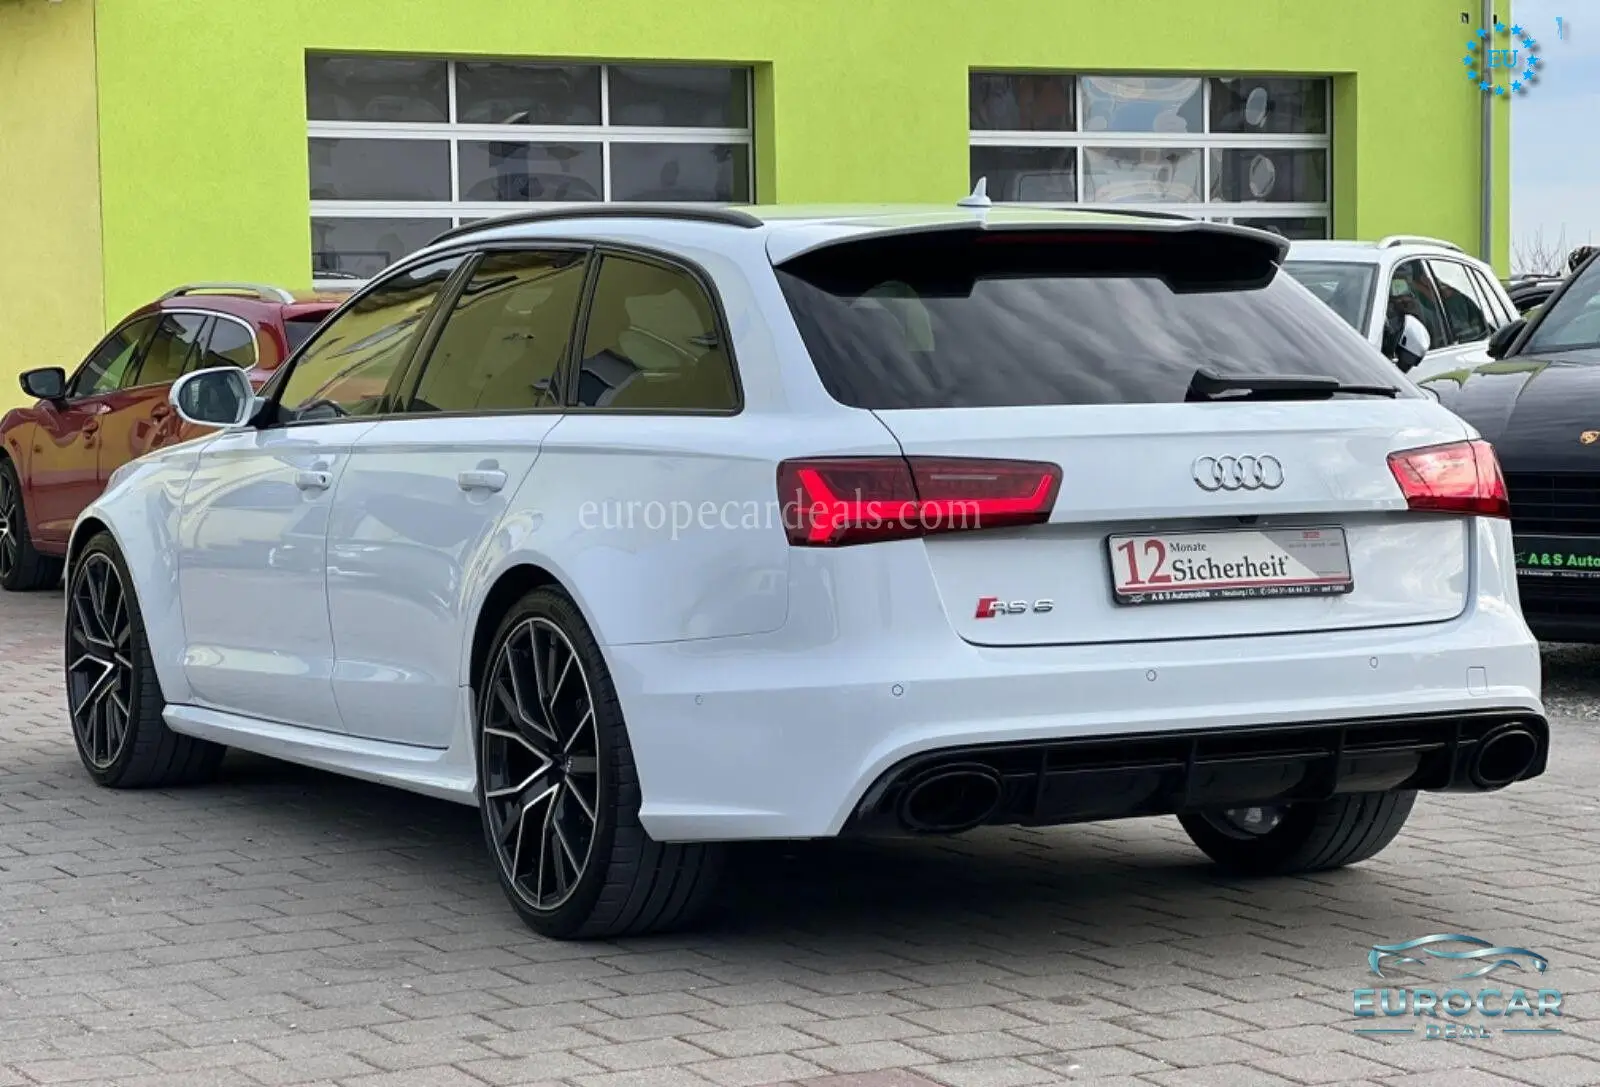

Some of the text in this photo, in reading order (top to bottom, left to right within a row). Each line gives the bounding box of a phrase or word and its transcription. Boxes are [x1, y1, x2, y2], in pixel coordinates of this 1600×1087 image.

[1169, 542, 1207, 553] Monate
[1117, 539, 1172, 586] 12
[1528, 552, 1539, 565] A
[1541, 553, 1551, 566] &
[1553, 553, 1563, 566] S
[984, 599, 1055, 616] RS 6
